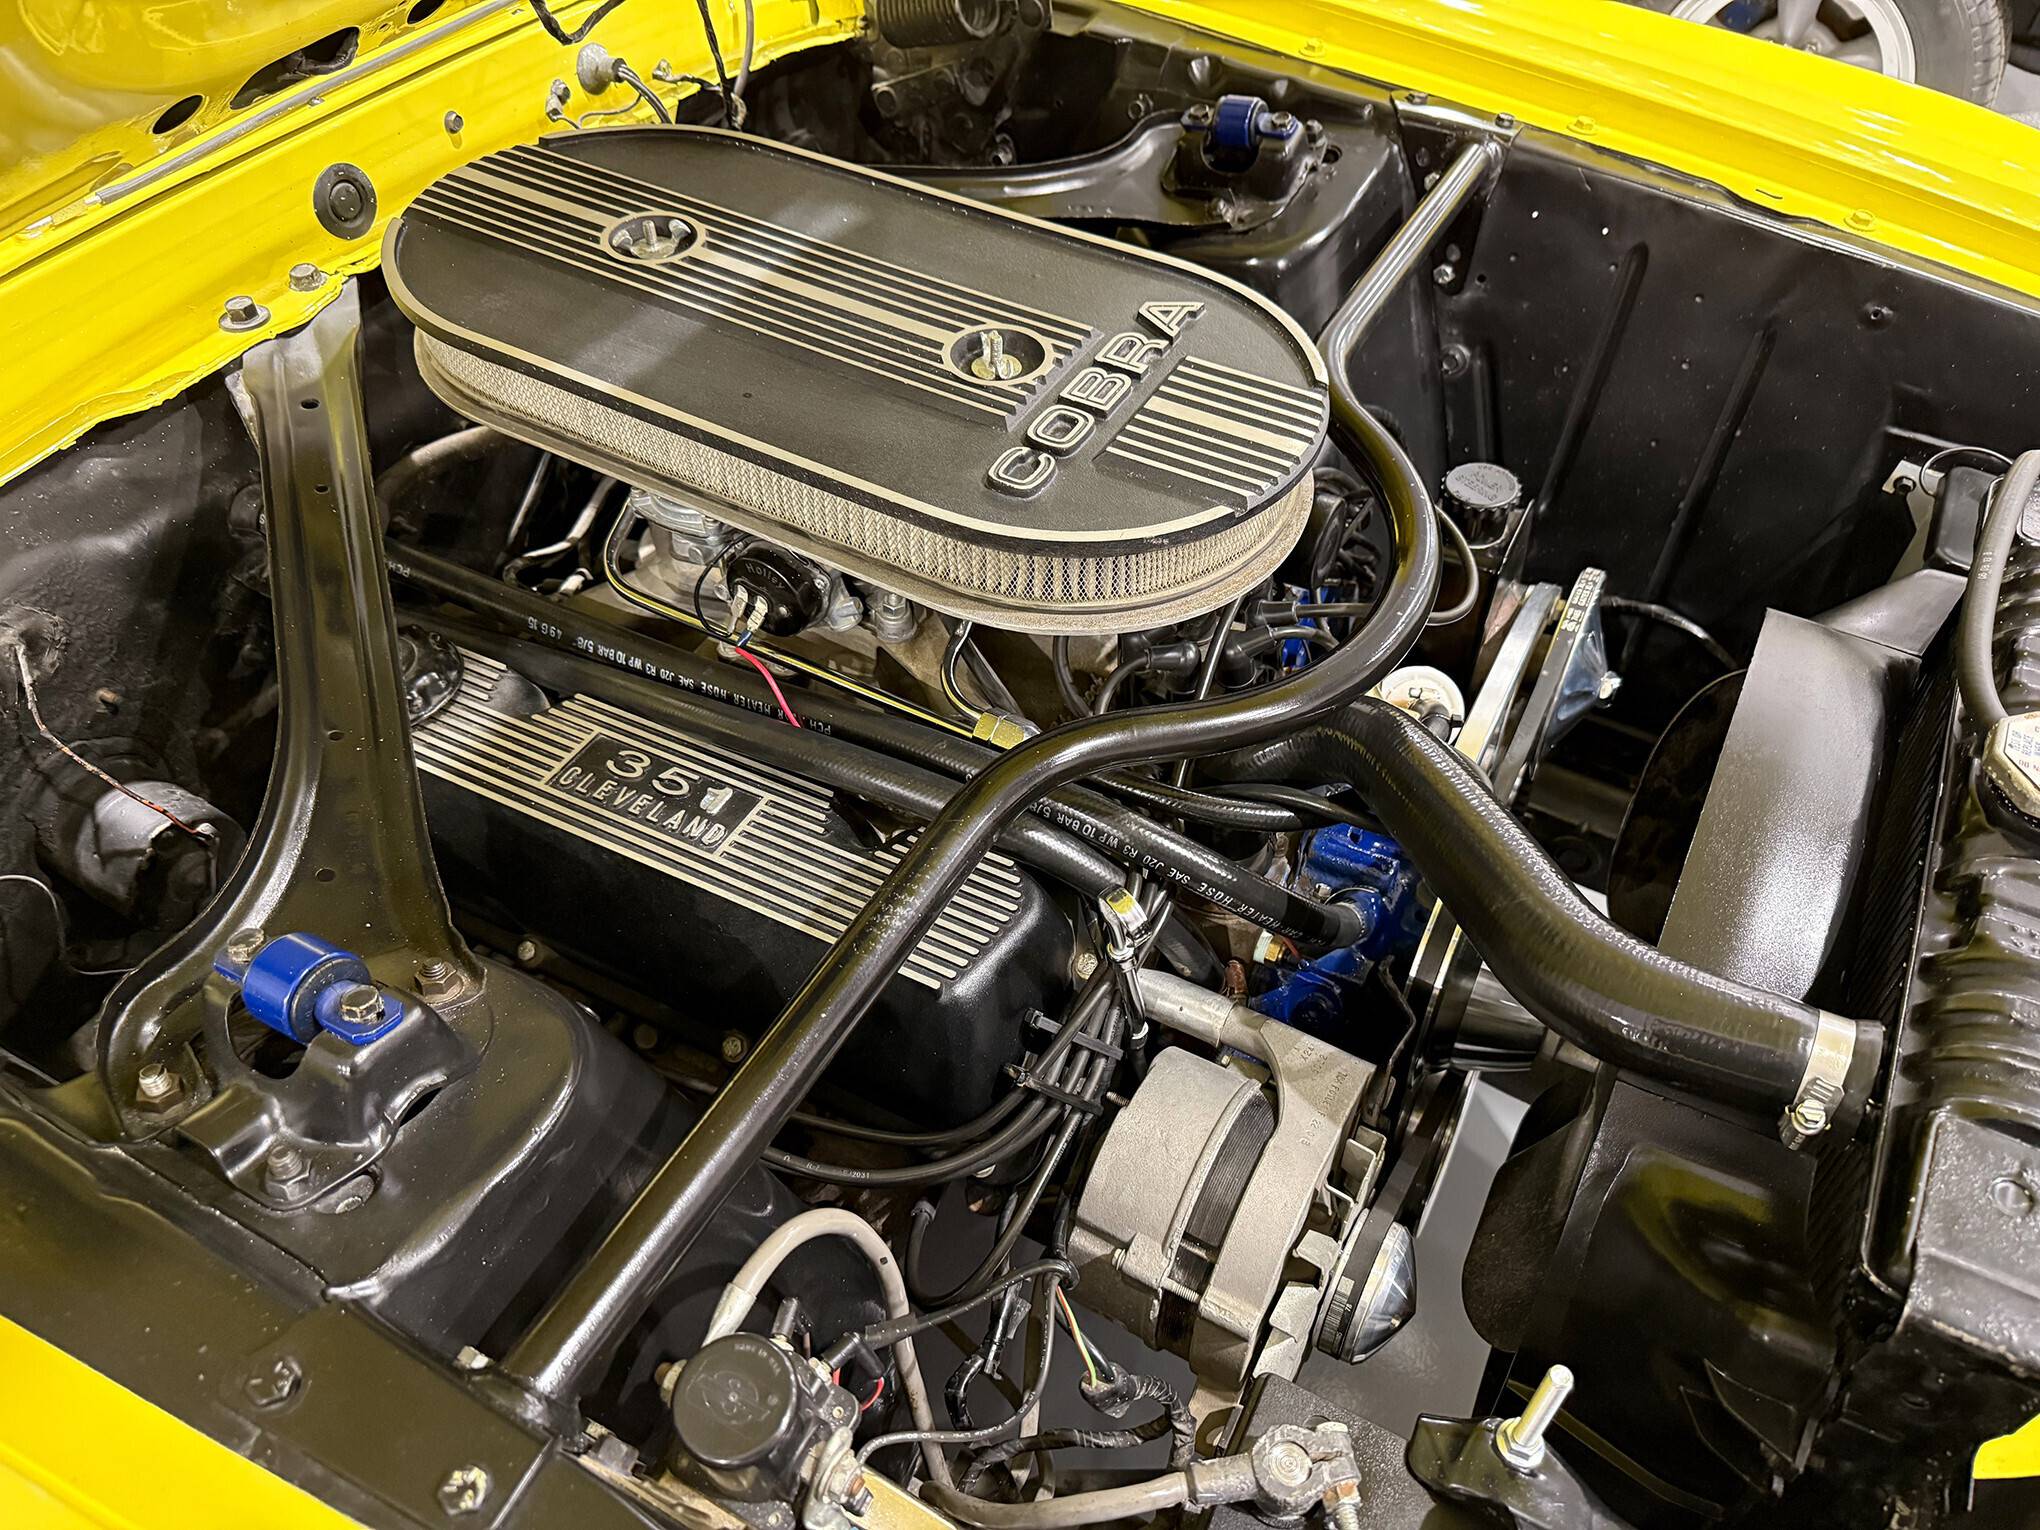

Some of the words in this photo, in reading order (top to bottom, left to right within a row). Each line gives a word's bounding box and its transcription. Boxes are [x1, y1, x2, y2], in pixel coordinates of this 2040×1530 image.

[988, 301, 1205, 490] COBRA
[744, 561, 784, 588] Holley
[596, 643, 616, 660] BAR
[615, 650, 628, 664] 10
[627, 654, 643, 669] WP
[644, 662, 656, 675] R3
[659, 667, 675, 682] J20
[678, 675, 695, 689] SAE
[700, 681, 727, 699] HOSE
[733, 693, 772, 715] HEATER
[605, 750, 734, 815] 351
[558, 766, 727, 845] CLEVELAND
[1055, 811, 1081, 830] BAR
[1081, 823, 1098, 838] 10
[1098, 831, 1120, 849] WP
[1121, 844, 1139, 859] R3
[1142, 854, 1165, 872] J20
[1167, 866, 1191, 885] SAE
[1197, 880, 1233, 907] HOSE
[1237, 902, 1281, 931] HEATER
